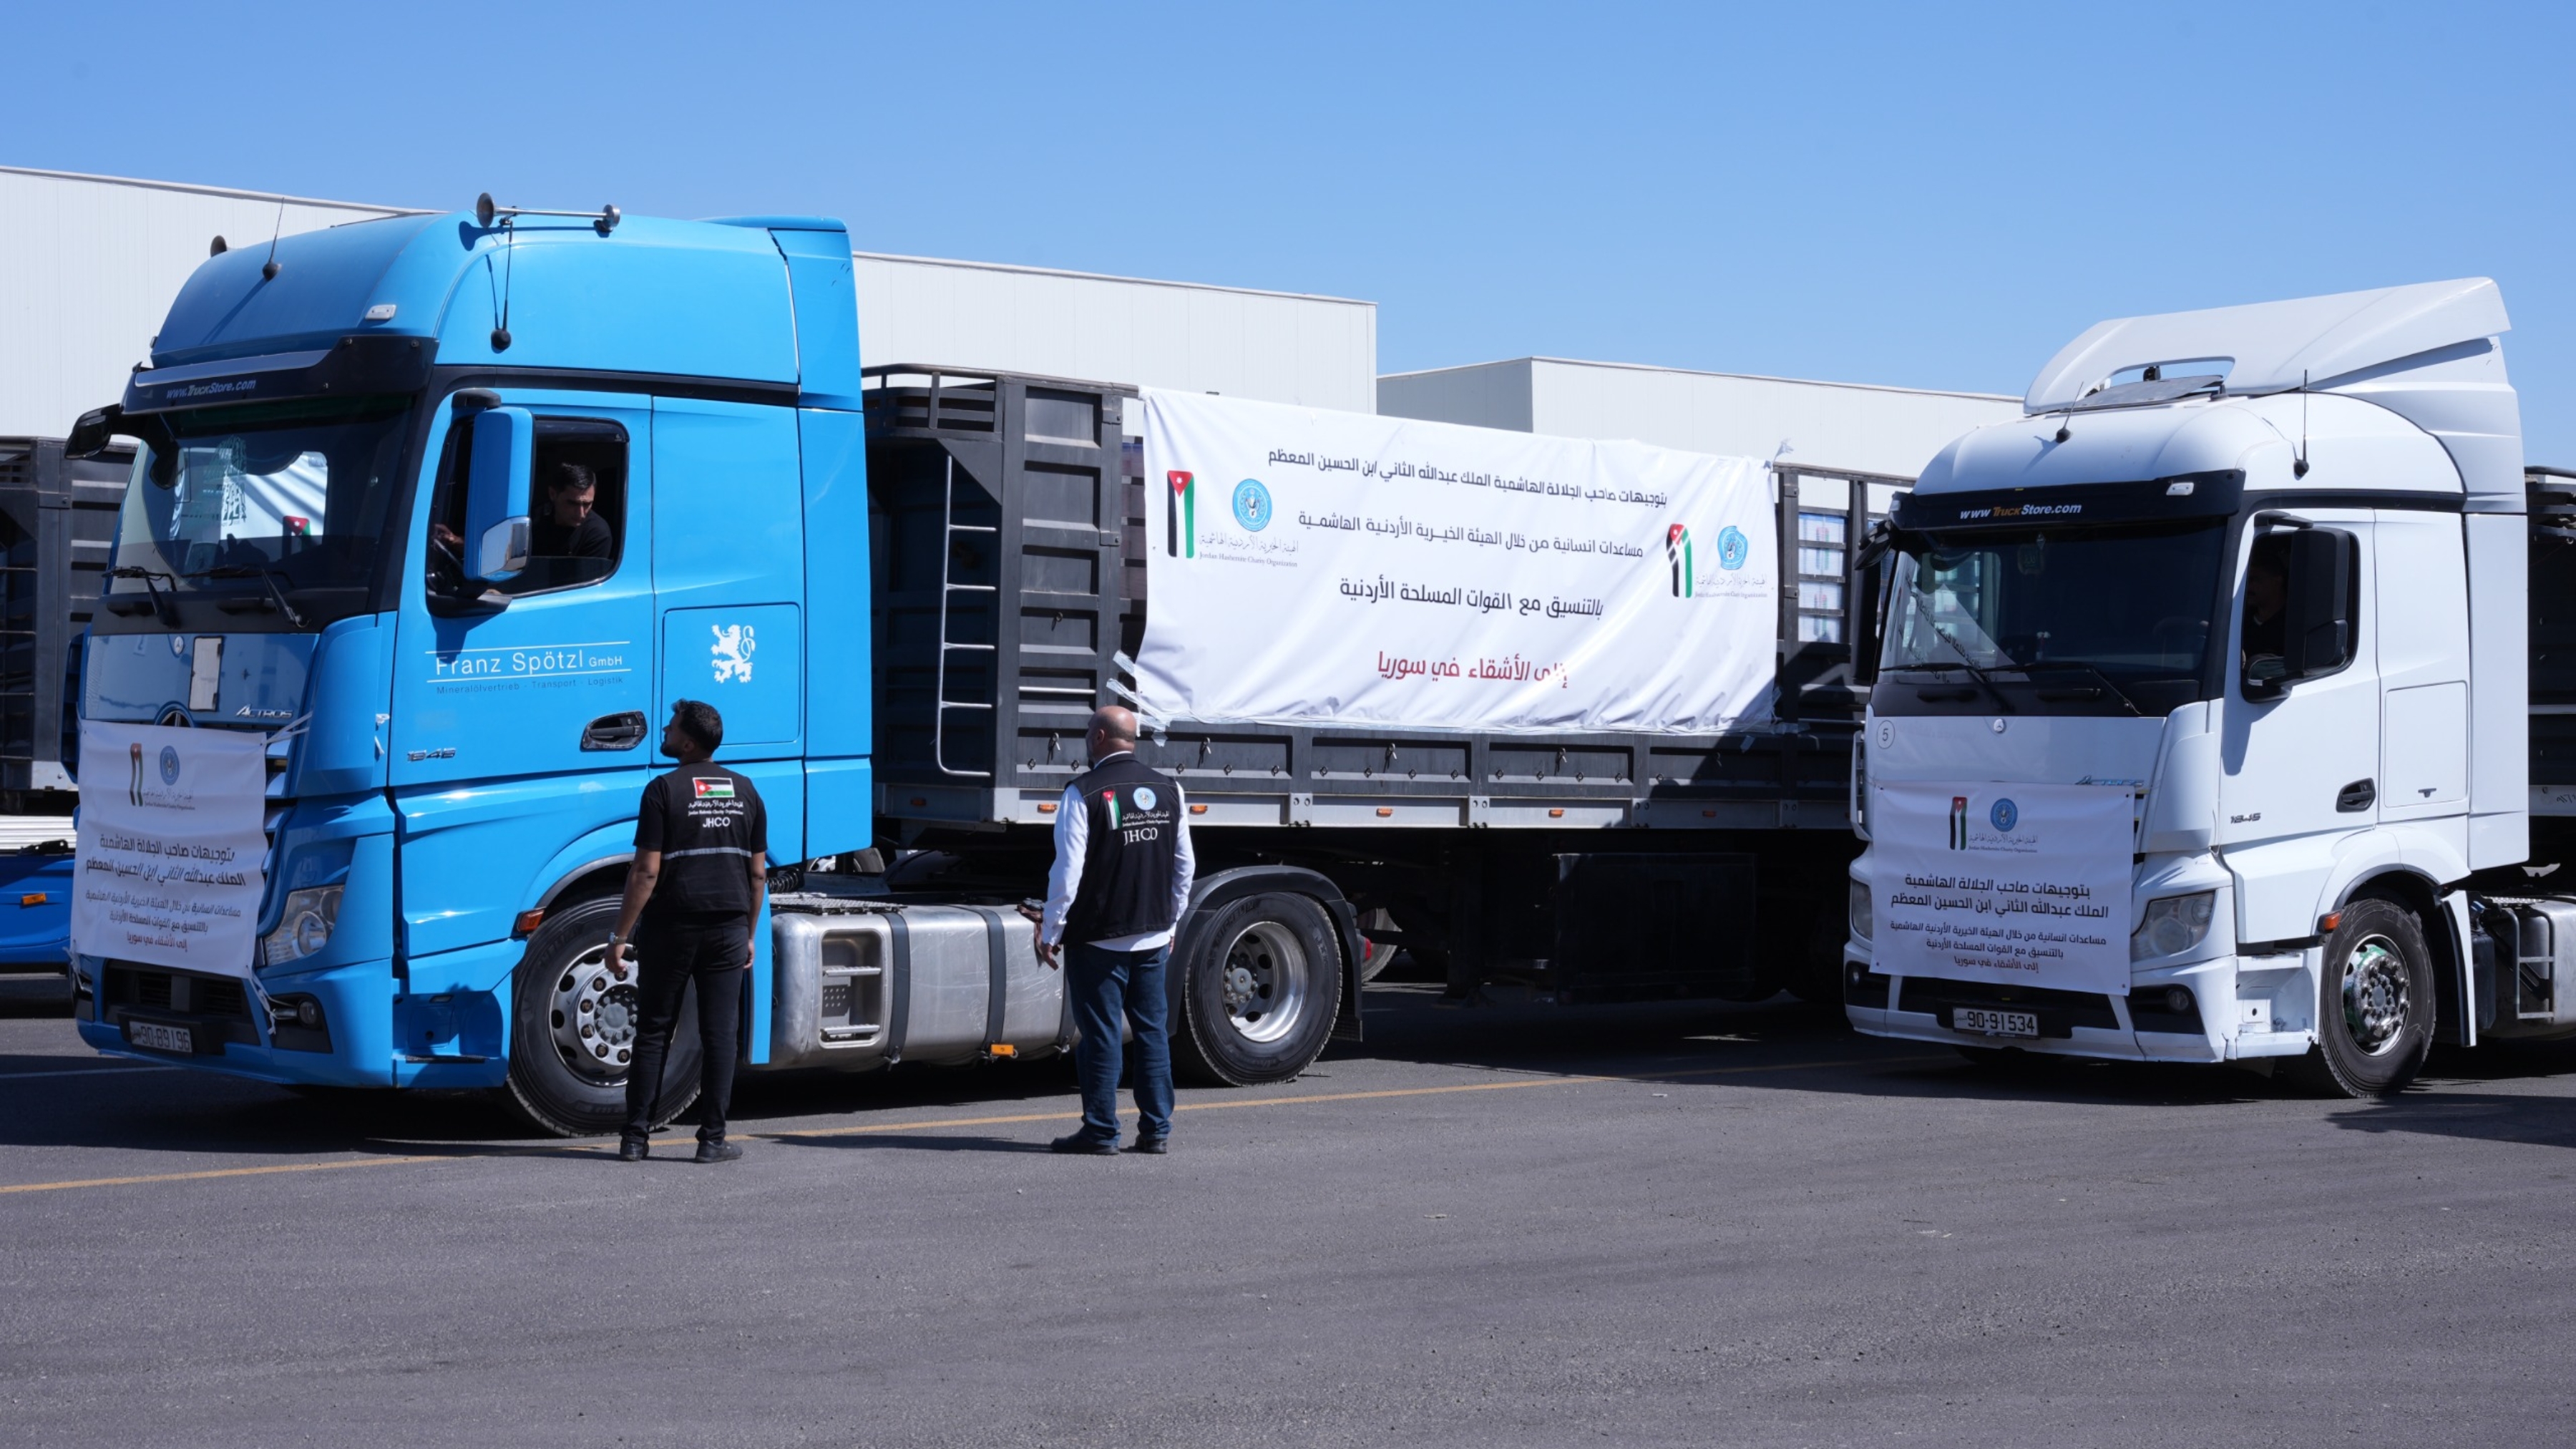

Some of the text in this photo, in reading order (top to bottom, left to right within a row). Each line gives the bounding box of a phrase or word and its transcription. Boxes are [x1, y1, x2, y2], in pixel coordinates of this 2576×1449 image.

[1269, 449, 1667, 508] بتوجيهات صاحب الجلالة الهاشمية الملك عبدالله الثاني ابن الحسين المعظم
[1366, 516, 1412, 538] الأردنية
[1468, 527, 1502, 547] الهيئة
[1506, 532, 1525, 550] خلال
[1529, 539, 1549, 552] من
[1553, 537, 1596, 554] انسانية
[1599, 537, 1643, 557] مساعدات
[1199, 551, 1217, 560] Jordan
[1340, 575, 1604, 620] بالتنسيق مع القوات المسلحة الأردنية
[436, 649, 623, 675] Franz Spötzl GmbH
[1377, 650, 1426, 680] سوريا
[1432, 658, 1460, 681] في
[1468, 653, 1531, 681] الأشقاء
[436, 676, 624, 695] Mineralölvertrieb Transport Logistik
[1882, 727, 1889, 742] 5
[703, 816, 731, 828] JHCO
[1123, 827, 1158, 846] JHCO
[100, 834, 235, 865] بتوجيهات صاحب الجلالة الهاشمية
[86, 857, 246, 887] الملك عبدالله الثاني ابن الحسين المعظم
[1905, 874, 2090, 899] بتوجيهات صاحب الجلالة الهاشمية
[1891, 892, 2109, 919] الملك عبدالله الثاني ابن الحسين المعظم
[1890, 920, 2107, 945] مساعدات انسانية من خلال الهيئة الخيرية الأردنية الهاشمية
[1926, 937, 2064, 960] بالتنسيق مع القوات المسلحة الأردنية
[1954, 955, 2039, 974] إلى الأشقاء في سوريا
[1968, 1011, 2034, 1033] 90-91534
